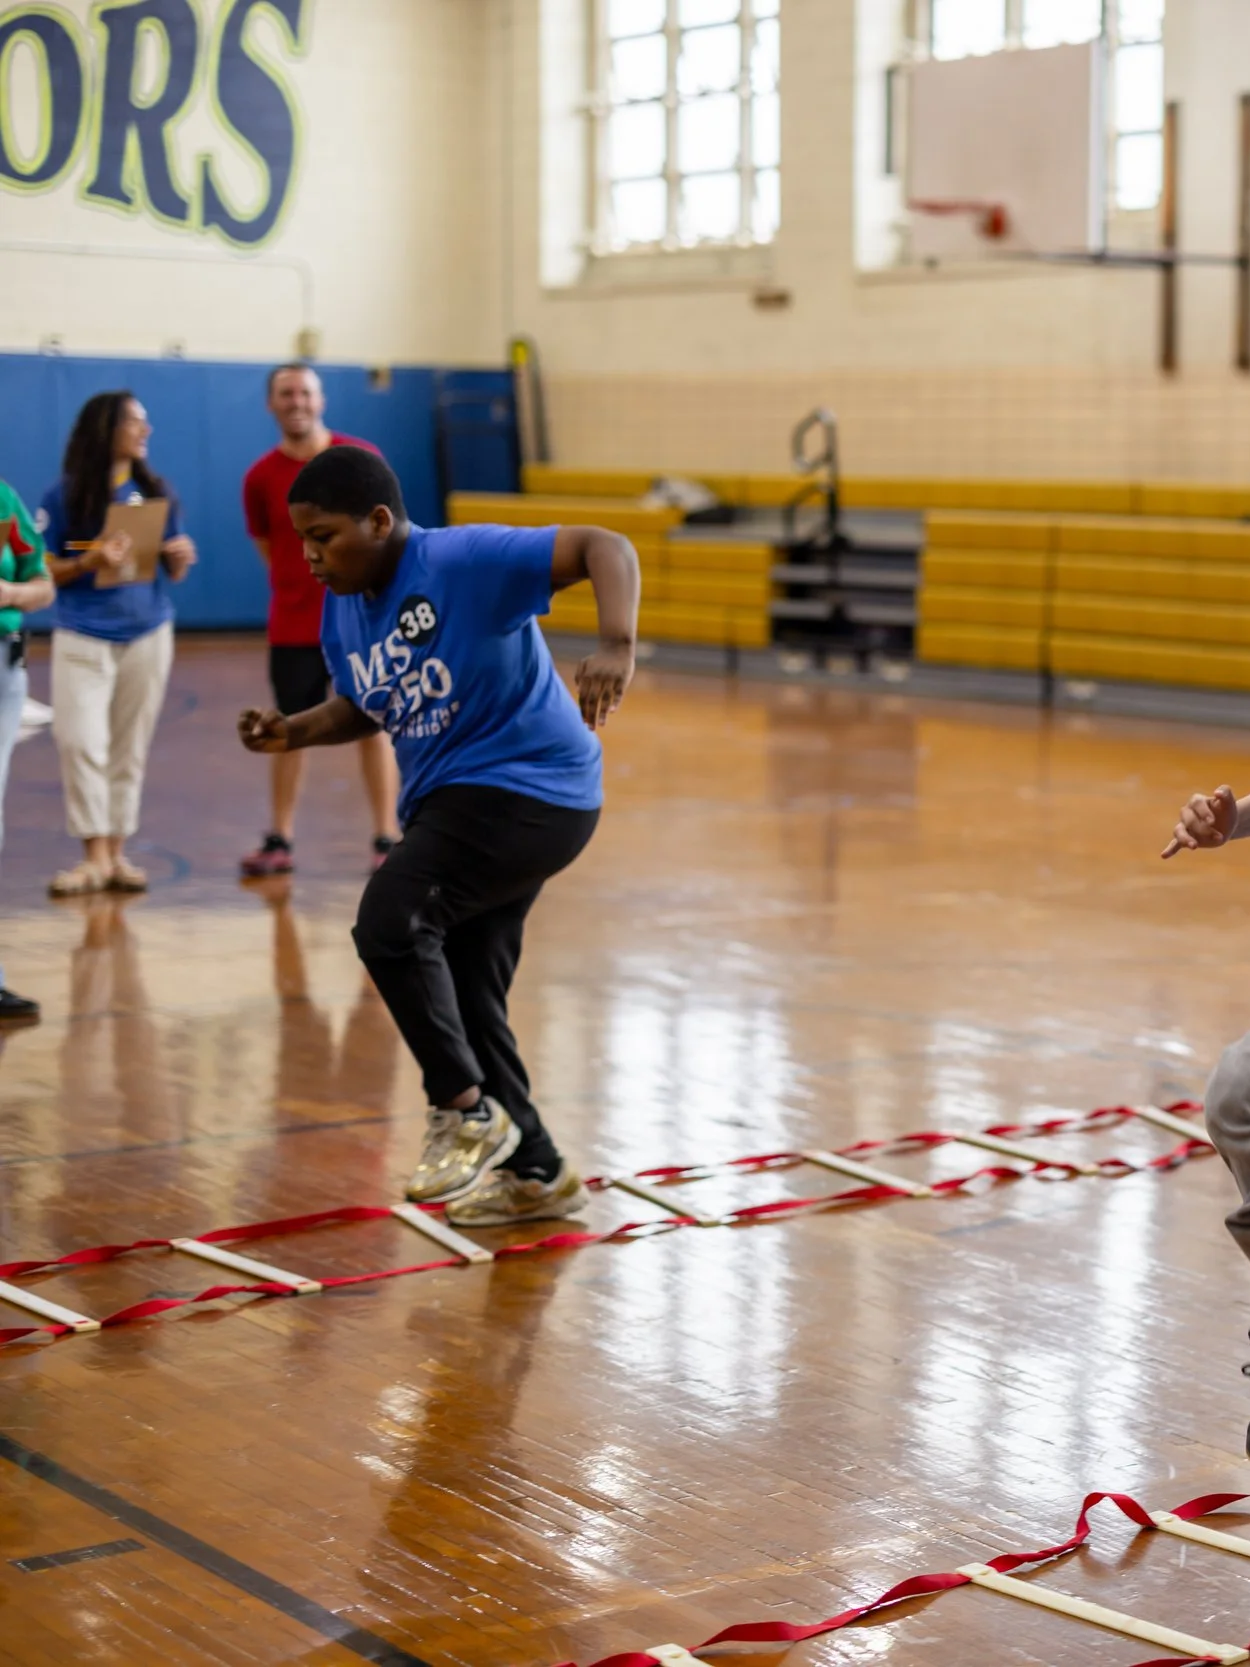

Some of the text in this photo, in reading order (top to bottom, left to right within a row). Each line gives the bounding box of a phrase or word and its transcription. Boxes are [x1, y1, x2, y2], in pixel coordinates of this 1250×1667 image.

[400, 602, 436, 639] 38
[347, 628, 412, 695] MS
[400, 657, 452, 714] 50
